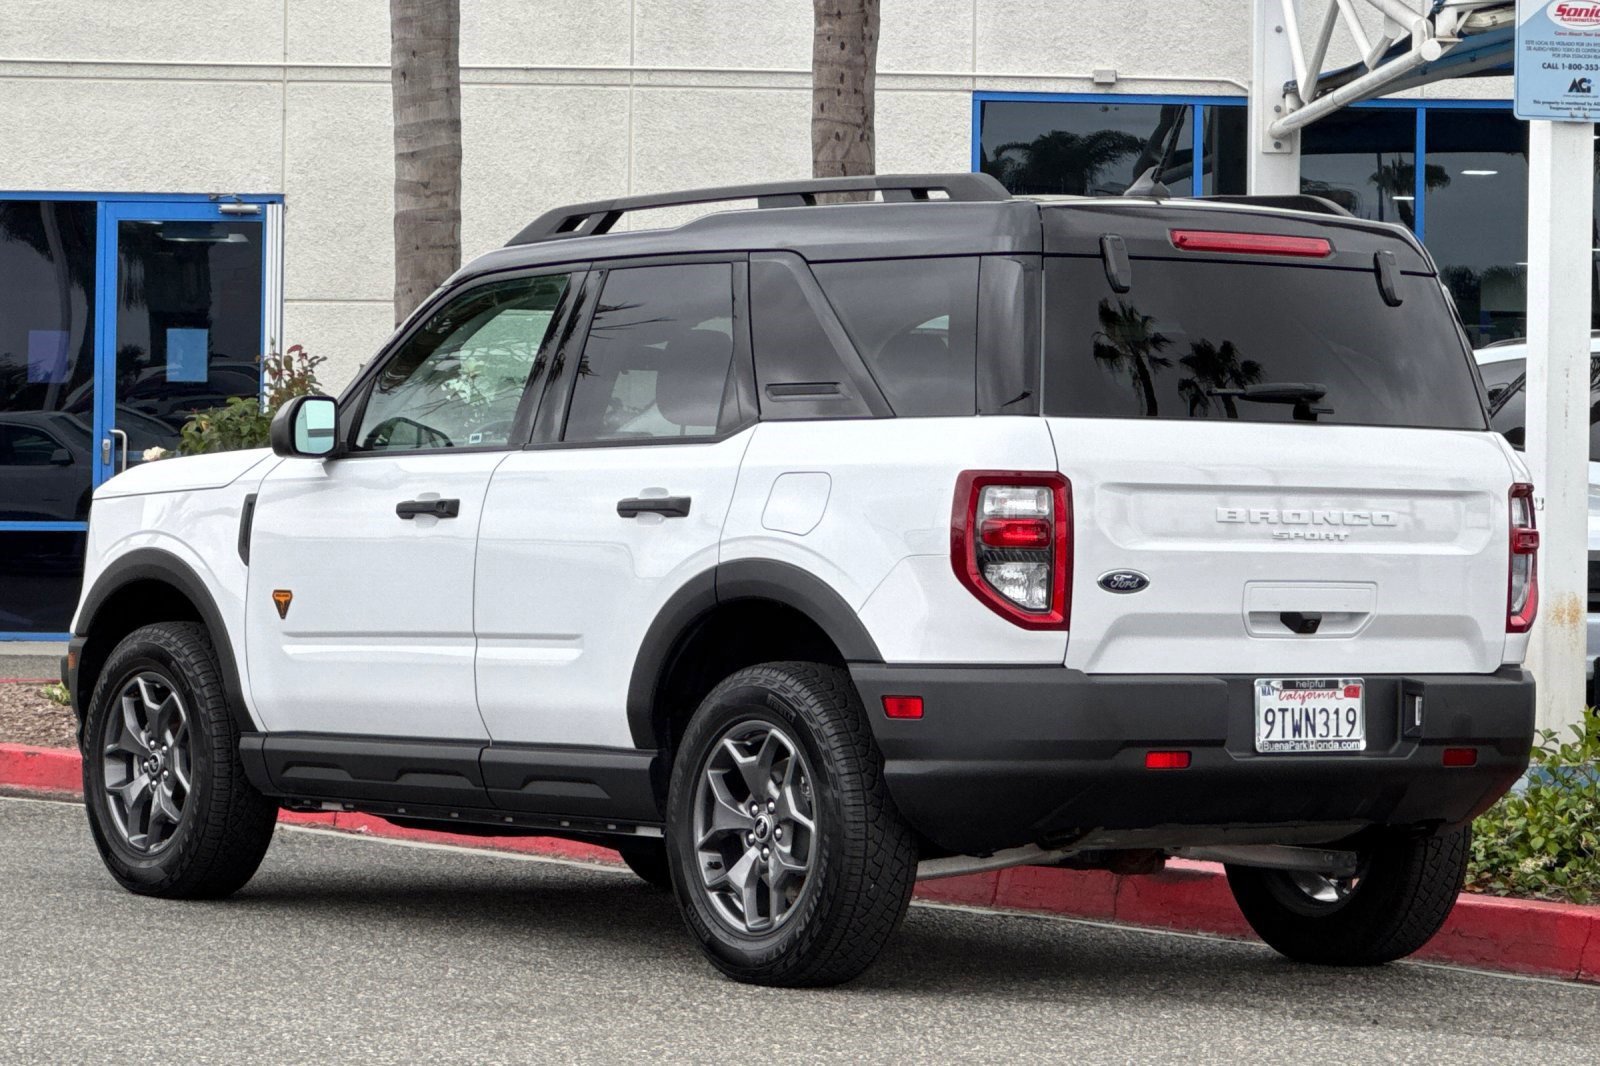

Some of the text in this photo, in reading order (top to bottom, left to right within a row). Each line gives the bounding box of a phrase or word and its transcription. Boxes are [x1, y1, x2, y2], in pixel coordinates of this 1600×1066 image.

[1542, 62, 1559, 70] CALL
[1216, 507, 1397, 527] BRONCO
[1272, 530, 1350, 541] SPORT
[1110, 574, 1140, 588] Ford
[1261, 686, 1275, 696] MAY
[1295, 680, 1326, 690] helpful
[1278, 689, 1344, 705] California
[1264, 707, 1357, 739] 9TWN319
